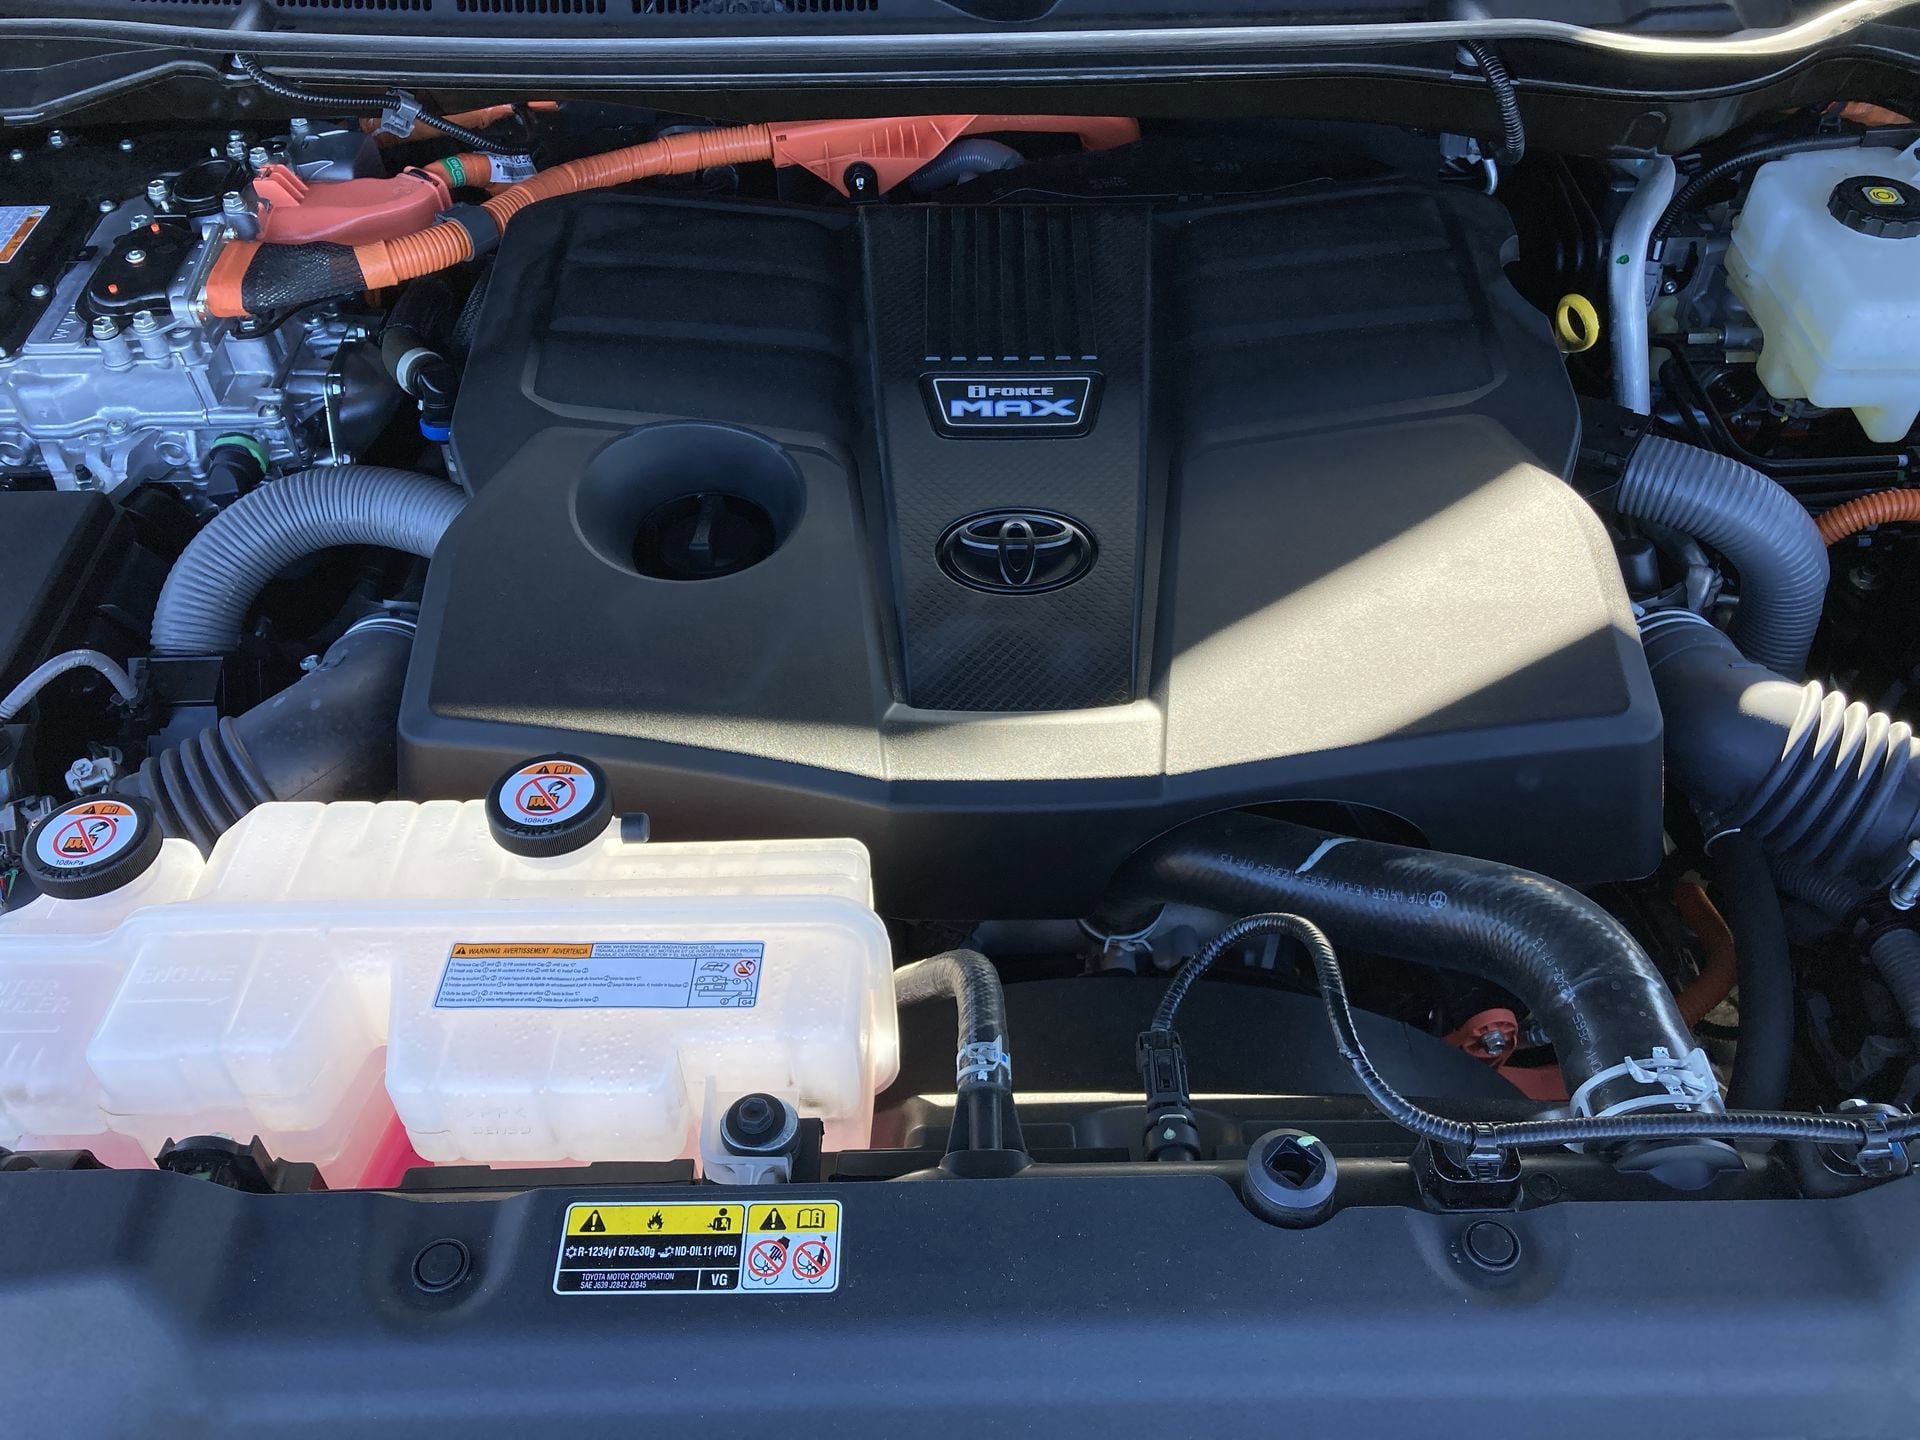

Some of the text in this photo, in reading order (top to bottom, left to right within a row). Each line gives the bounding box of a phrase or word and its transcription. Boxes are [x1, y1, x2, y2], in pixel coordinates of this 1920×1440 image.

[950, 399, 1076, 417] MAX
[524, 816, 553, 824] 108kPa
[55, 858, 85, 866] 108kPa
[468, 947, 500, 955] WARNING
[552, 947, 588, 955] ADVERTENCIA
[577, 1246, 656, 1258] R-1234yf 670±30g
[674, 1245, 737, 1258] ND-OIL11 (POE)
[582, 1273, 606, 1281] TOYOTA
[630, 1272, 675, 1280] CORPORATION
[711, 1273, 728, 1286] VG
[580, 1281, 647, 1289] SAE J639 J2842 J2845
